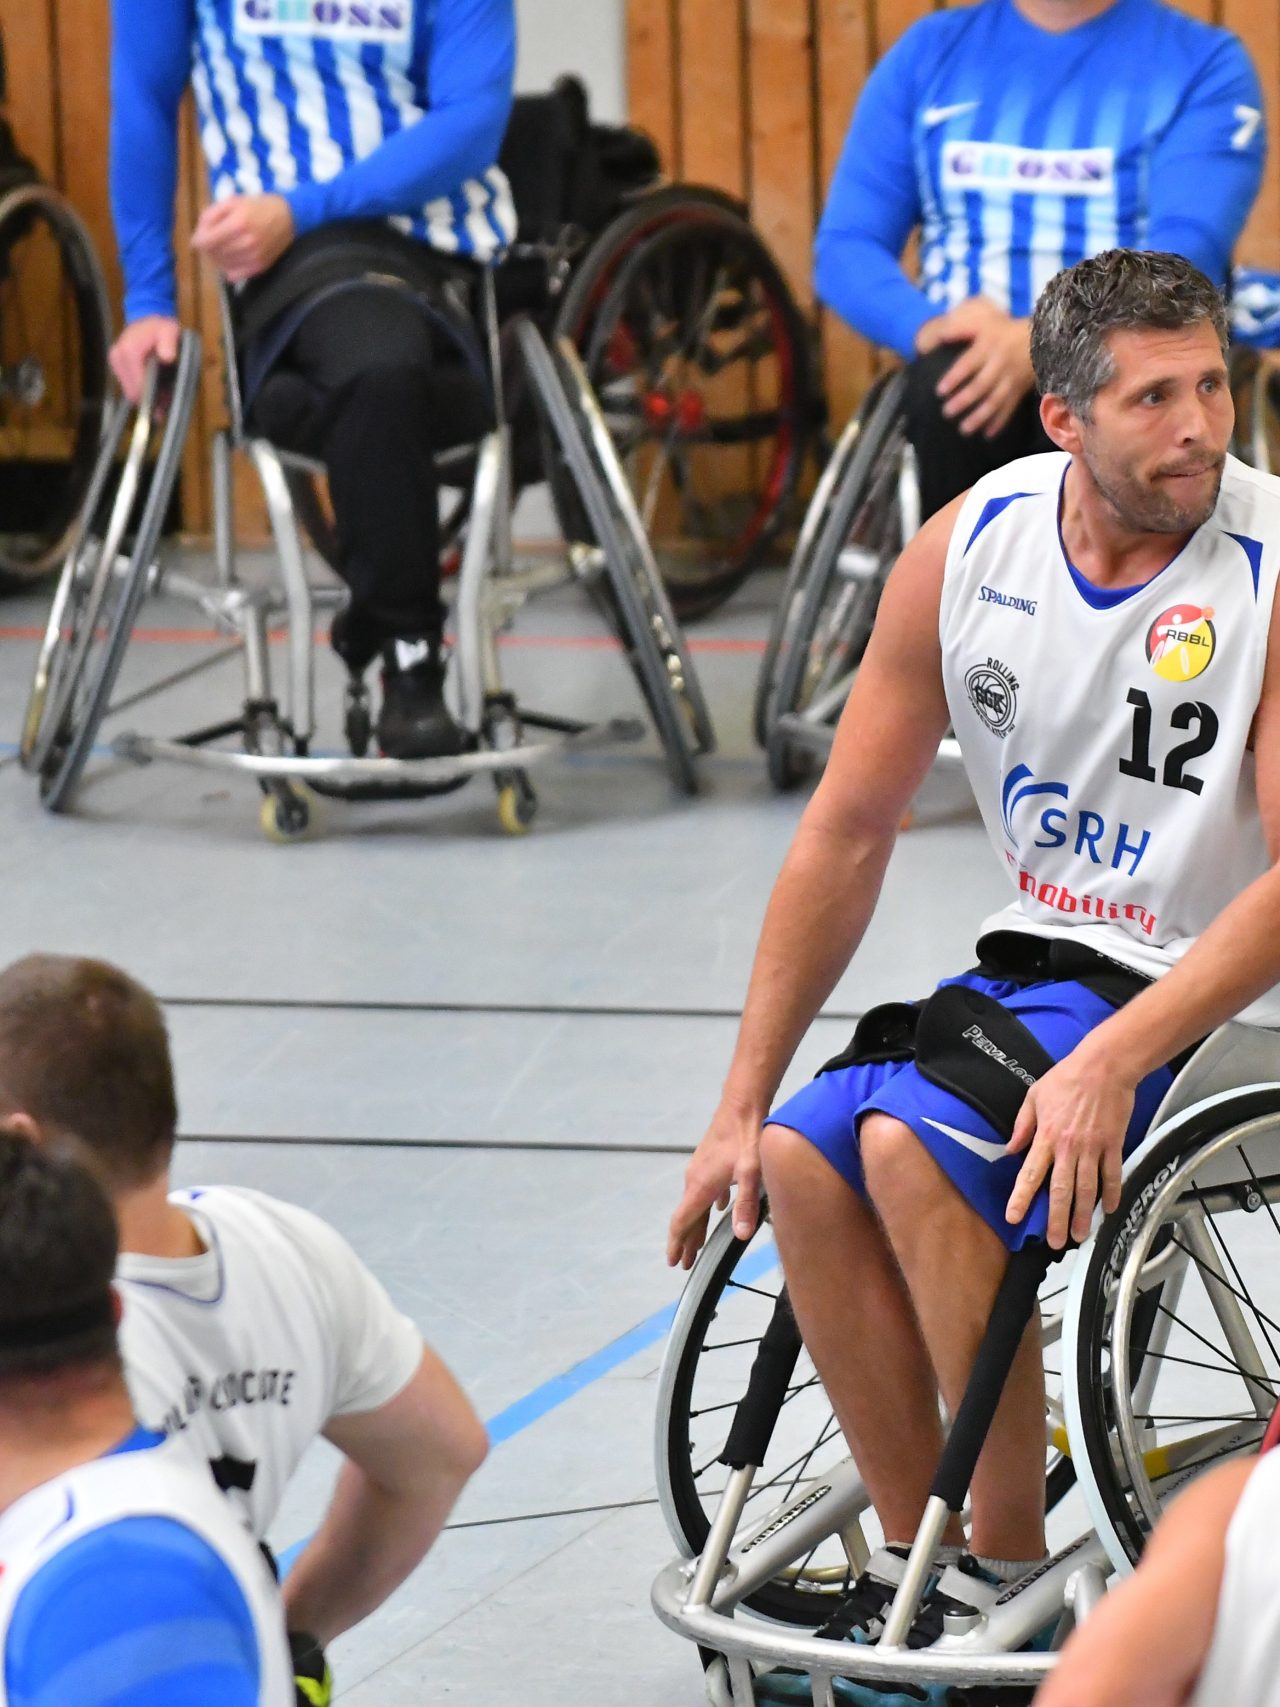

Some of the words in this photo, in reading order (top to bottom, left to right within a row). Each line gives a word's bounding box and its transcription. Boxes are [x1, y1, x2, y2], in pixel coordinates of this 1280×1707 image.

[1231, 105, 1260, 149] 7
[978, 585, 1038, 616] SPALDING
[1166, 629, 1210, 647] RBBL
[986, 656, 1020, 692] ROLLING
[1119, 687, 1219, 796] 12
[1034, 807, 1151, 877] SRH
